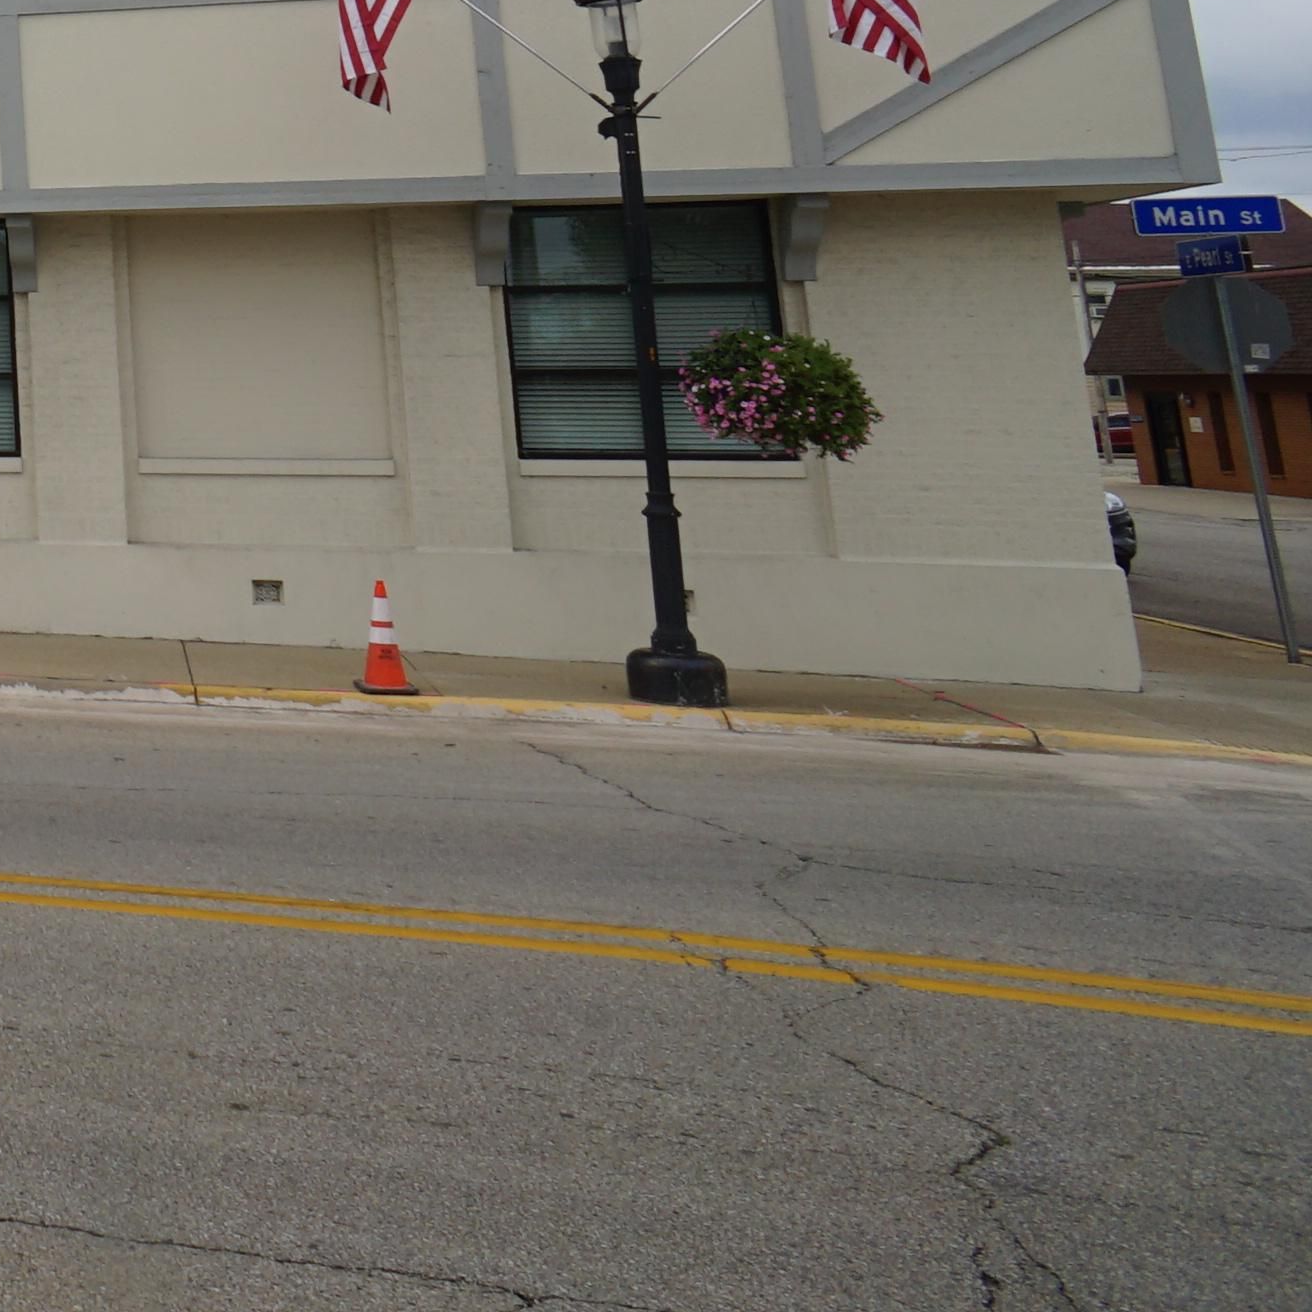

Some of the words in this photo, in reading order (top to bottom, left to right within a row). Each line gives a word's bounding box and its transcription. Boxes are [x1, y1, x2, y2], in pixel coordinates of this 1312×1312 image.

[1152, 206, 1226, 227] Main
[1240, 210, 1262, 225] St
[1193, 246, 1221, 268] Pearl
